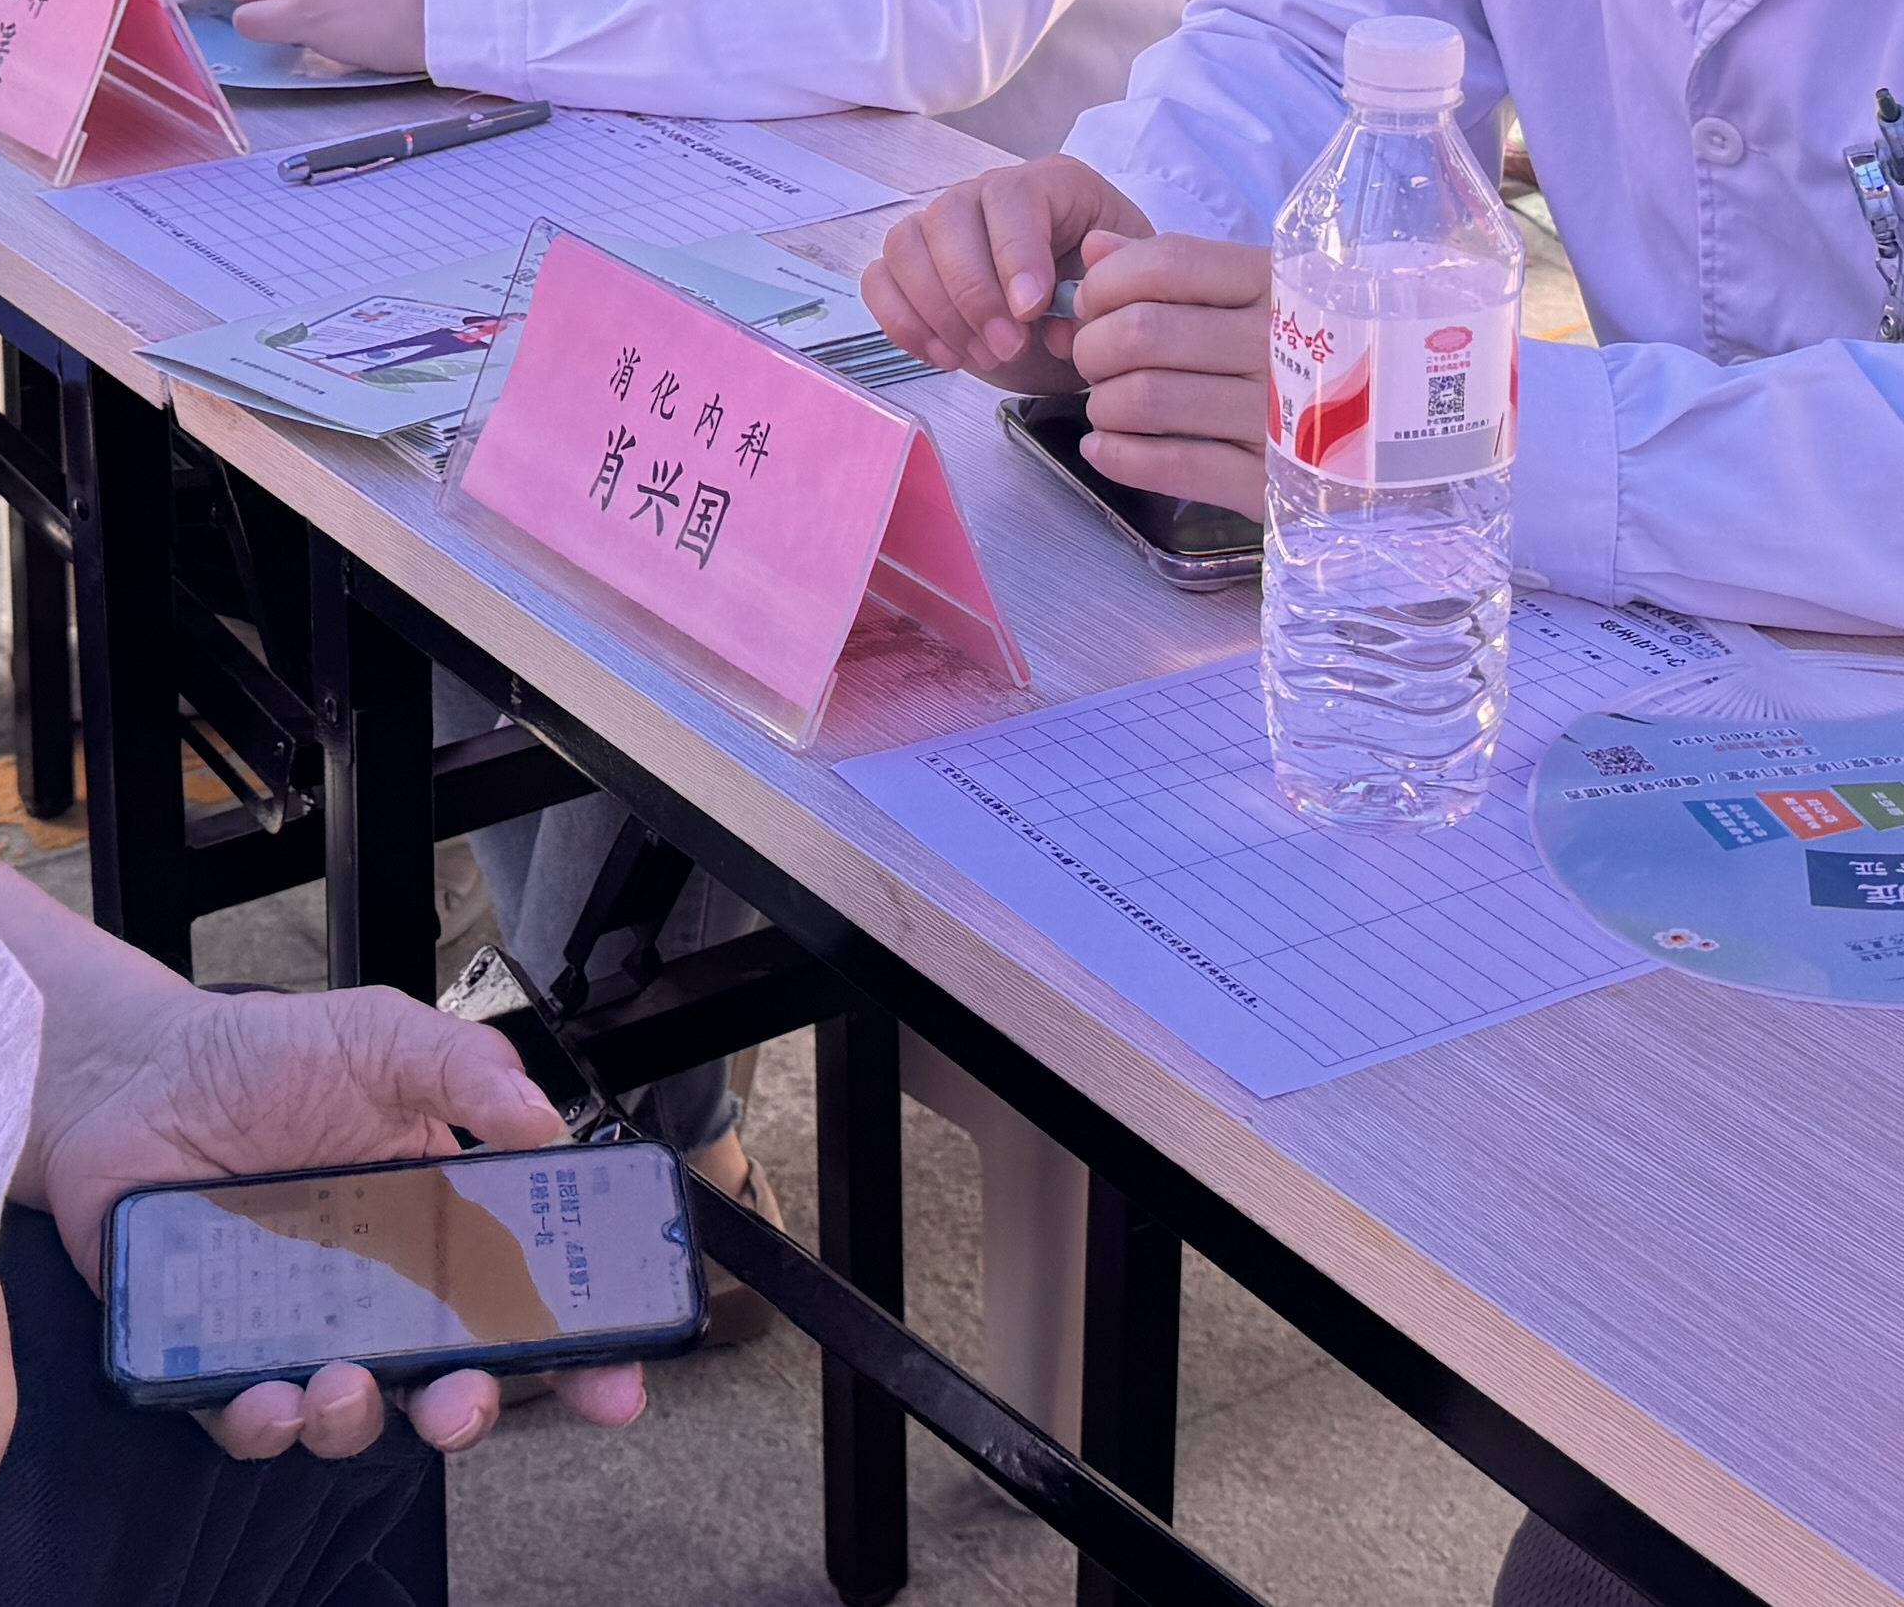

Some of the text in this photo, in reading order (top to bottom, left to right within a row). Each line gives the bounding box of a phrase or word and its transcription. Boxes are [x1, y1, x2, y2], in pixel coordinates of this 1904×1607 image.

[608, 345, 774, 479] 消化内科
[588, 424, 732, 571] 肖兴国
